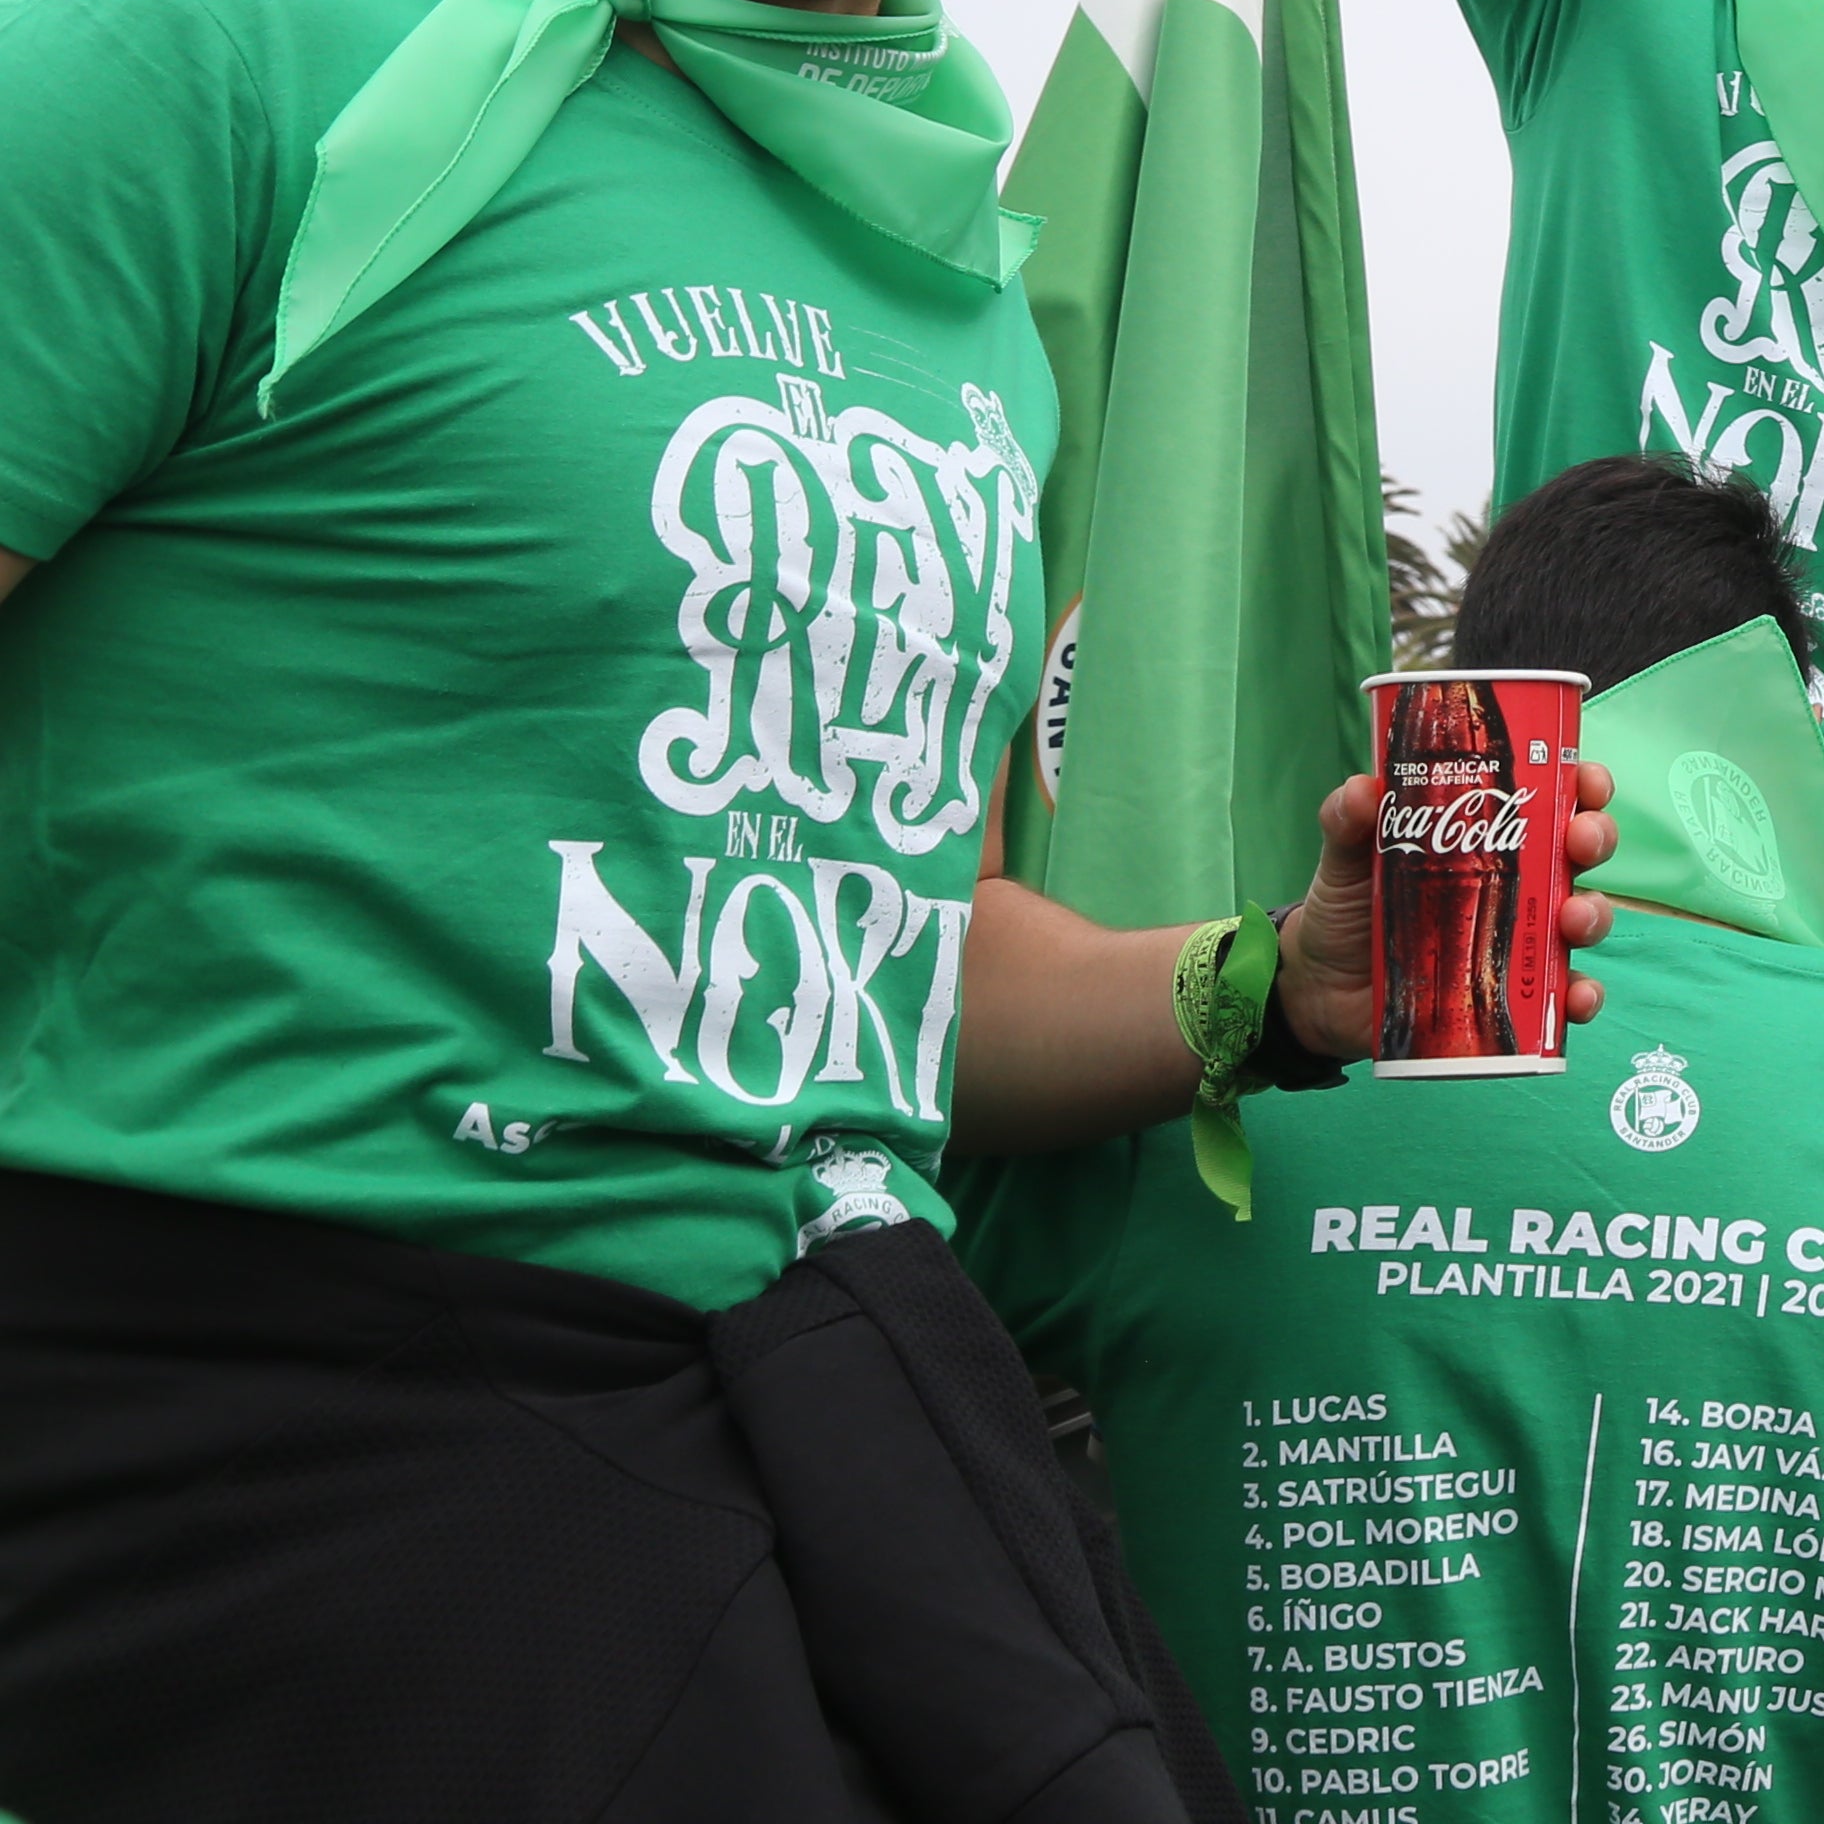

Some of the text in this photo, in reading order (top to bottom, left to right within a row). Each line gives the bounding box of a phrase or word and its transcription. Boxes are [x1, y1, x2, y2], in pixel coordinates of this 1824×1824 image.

[569, 286, 846, 380] VUELVE
[1743, 366, 1815, 414] EN EL
[1393, 758, 1500, 776] ZERO AZÚCAR
[1402, 773, 1483, 786] ZERO CAFEÍNA
[725, 811, 804, 863] EN EL
[1377, 787, 1537, 854] Coca-Cola
[543, 840, 972, 1121] NORT
[1310, 1205, 1488, 1253] REAL
[1509, 1208, 1767, 1265] RACING
[1376, 1261, 1635, 1302] PLANTILLA
[1646, 1269, 1743, 1308] 2021
[1243, 1394, 1388, 1426] 1. LUCAS
[1646, 1397, 1689, 1426] 14.
[1701, 1400, 1817, 1439] BORJA
[1242, 1432, 1458, 1468] 2. MANTILLA
[1640, 1438, 1682, 1466] 16.
[1691, 1442, 1765, 1472] JAVI
[1243, 1469, 1516, 1509] 3. SATRÚSTEGUI
[1245, 1508, 1519, 1550] 4. POL MORENO
[1246, 1553, 1481, 1591] 5. BOBADILLA
[1247, 1598, 1383, 1632] 6. ÍÑIGO
[1248, 1639, 1467, 1673] 7. A. BUSTOS
[1658, 1720, 1767, 1754] SIMÓN
[1657, 1758, 1773, 1792] JORRÍN
